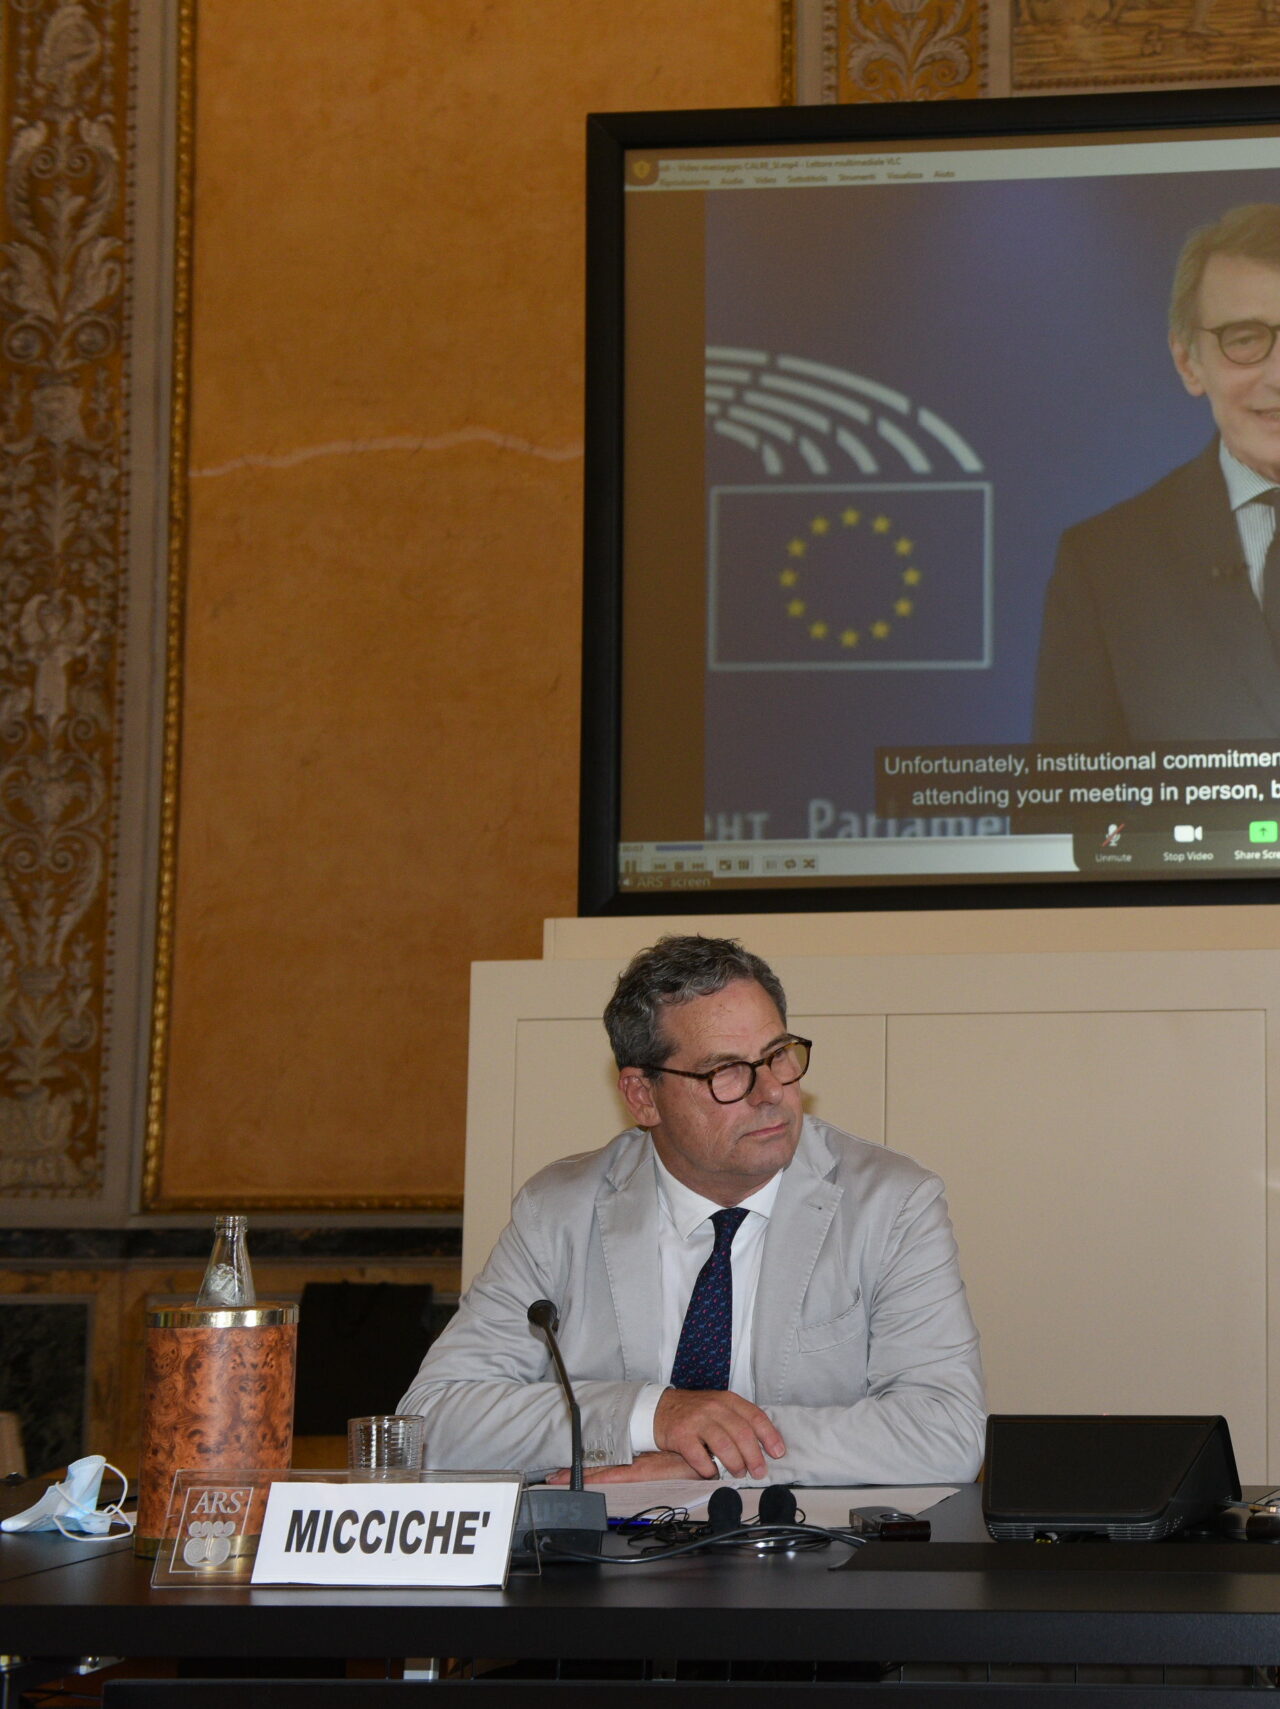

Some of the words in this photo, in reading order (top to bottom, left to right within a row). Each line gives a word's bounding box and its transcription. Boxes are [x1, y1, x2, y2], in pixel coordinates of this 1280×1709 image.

[885, 753, 1030, 777] Unfortunately,
[1037, 751, 1156, 772] institutional
[912, 786, 1009, 808] attending
[1017, 787, 1062, 808] your
[1070, 782, 1153, 806] meeting
[1160, 782, 1178, 801] in
[1185, 783, 1264, 805] person,
[1095, 853, 1132, 863] Unmute
[1163, 851, 1185, 863] Stop
[1187, 850, 1214, 861] Video
[1234, 849, 1258, 860] Share
[191, 1490, 244, 1514] ARS
[284, 1509, 490, 1555] MICCICHE'
